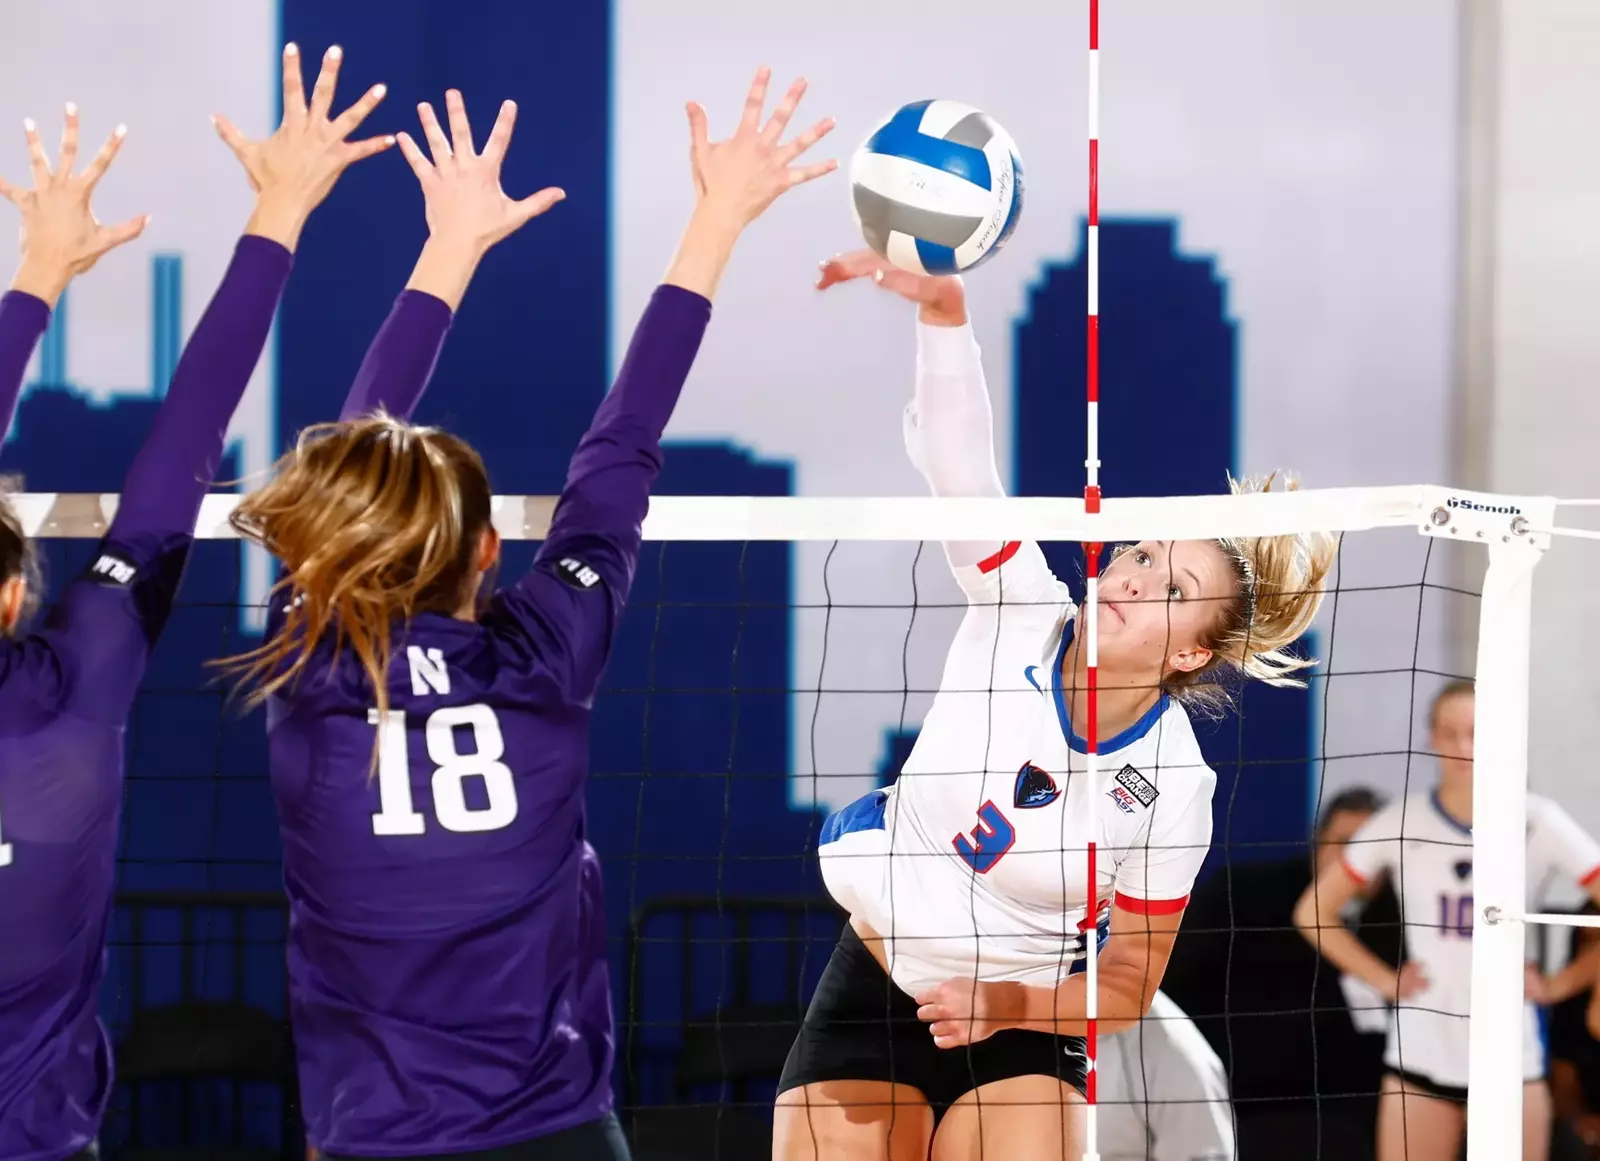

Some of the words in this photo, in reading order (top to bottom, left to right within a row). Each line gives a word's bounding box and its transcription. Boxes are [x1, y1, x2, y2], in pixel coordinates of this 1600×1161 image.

[1460, 499, 1521, 515] Senoh
[407, 645, 451, 696] N
[367, 703, 519, 835] 18
[1128, 772, 1147, 790] BE
[1115, 787, 1137, 805] BIG
[1117, 773, 1151, 805] CHANGE
[951, 799, 1016, 874] 3
